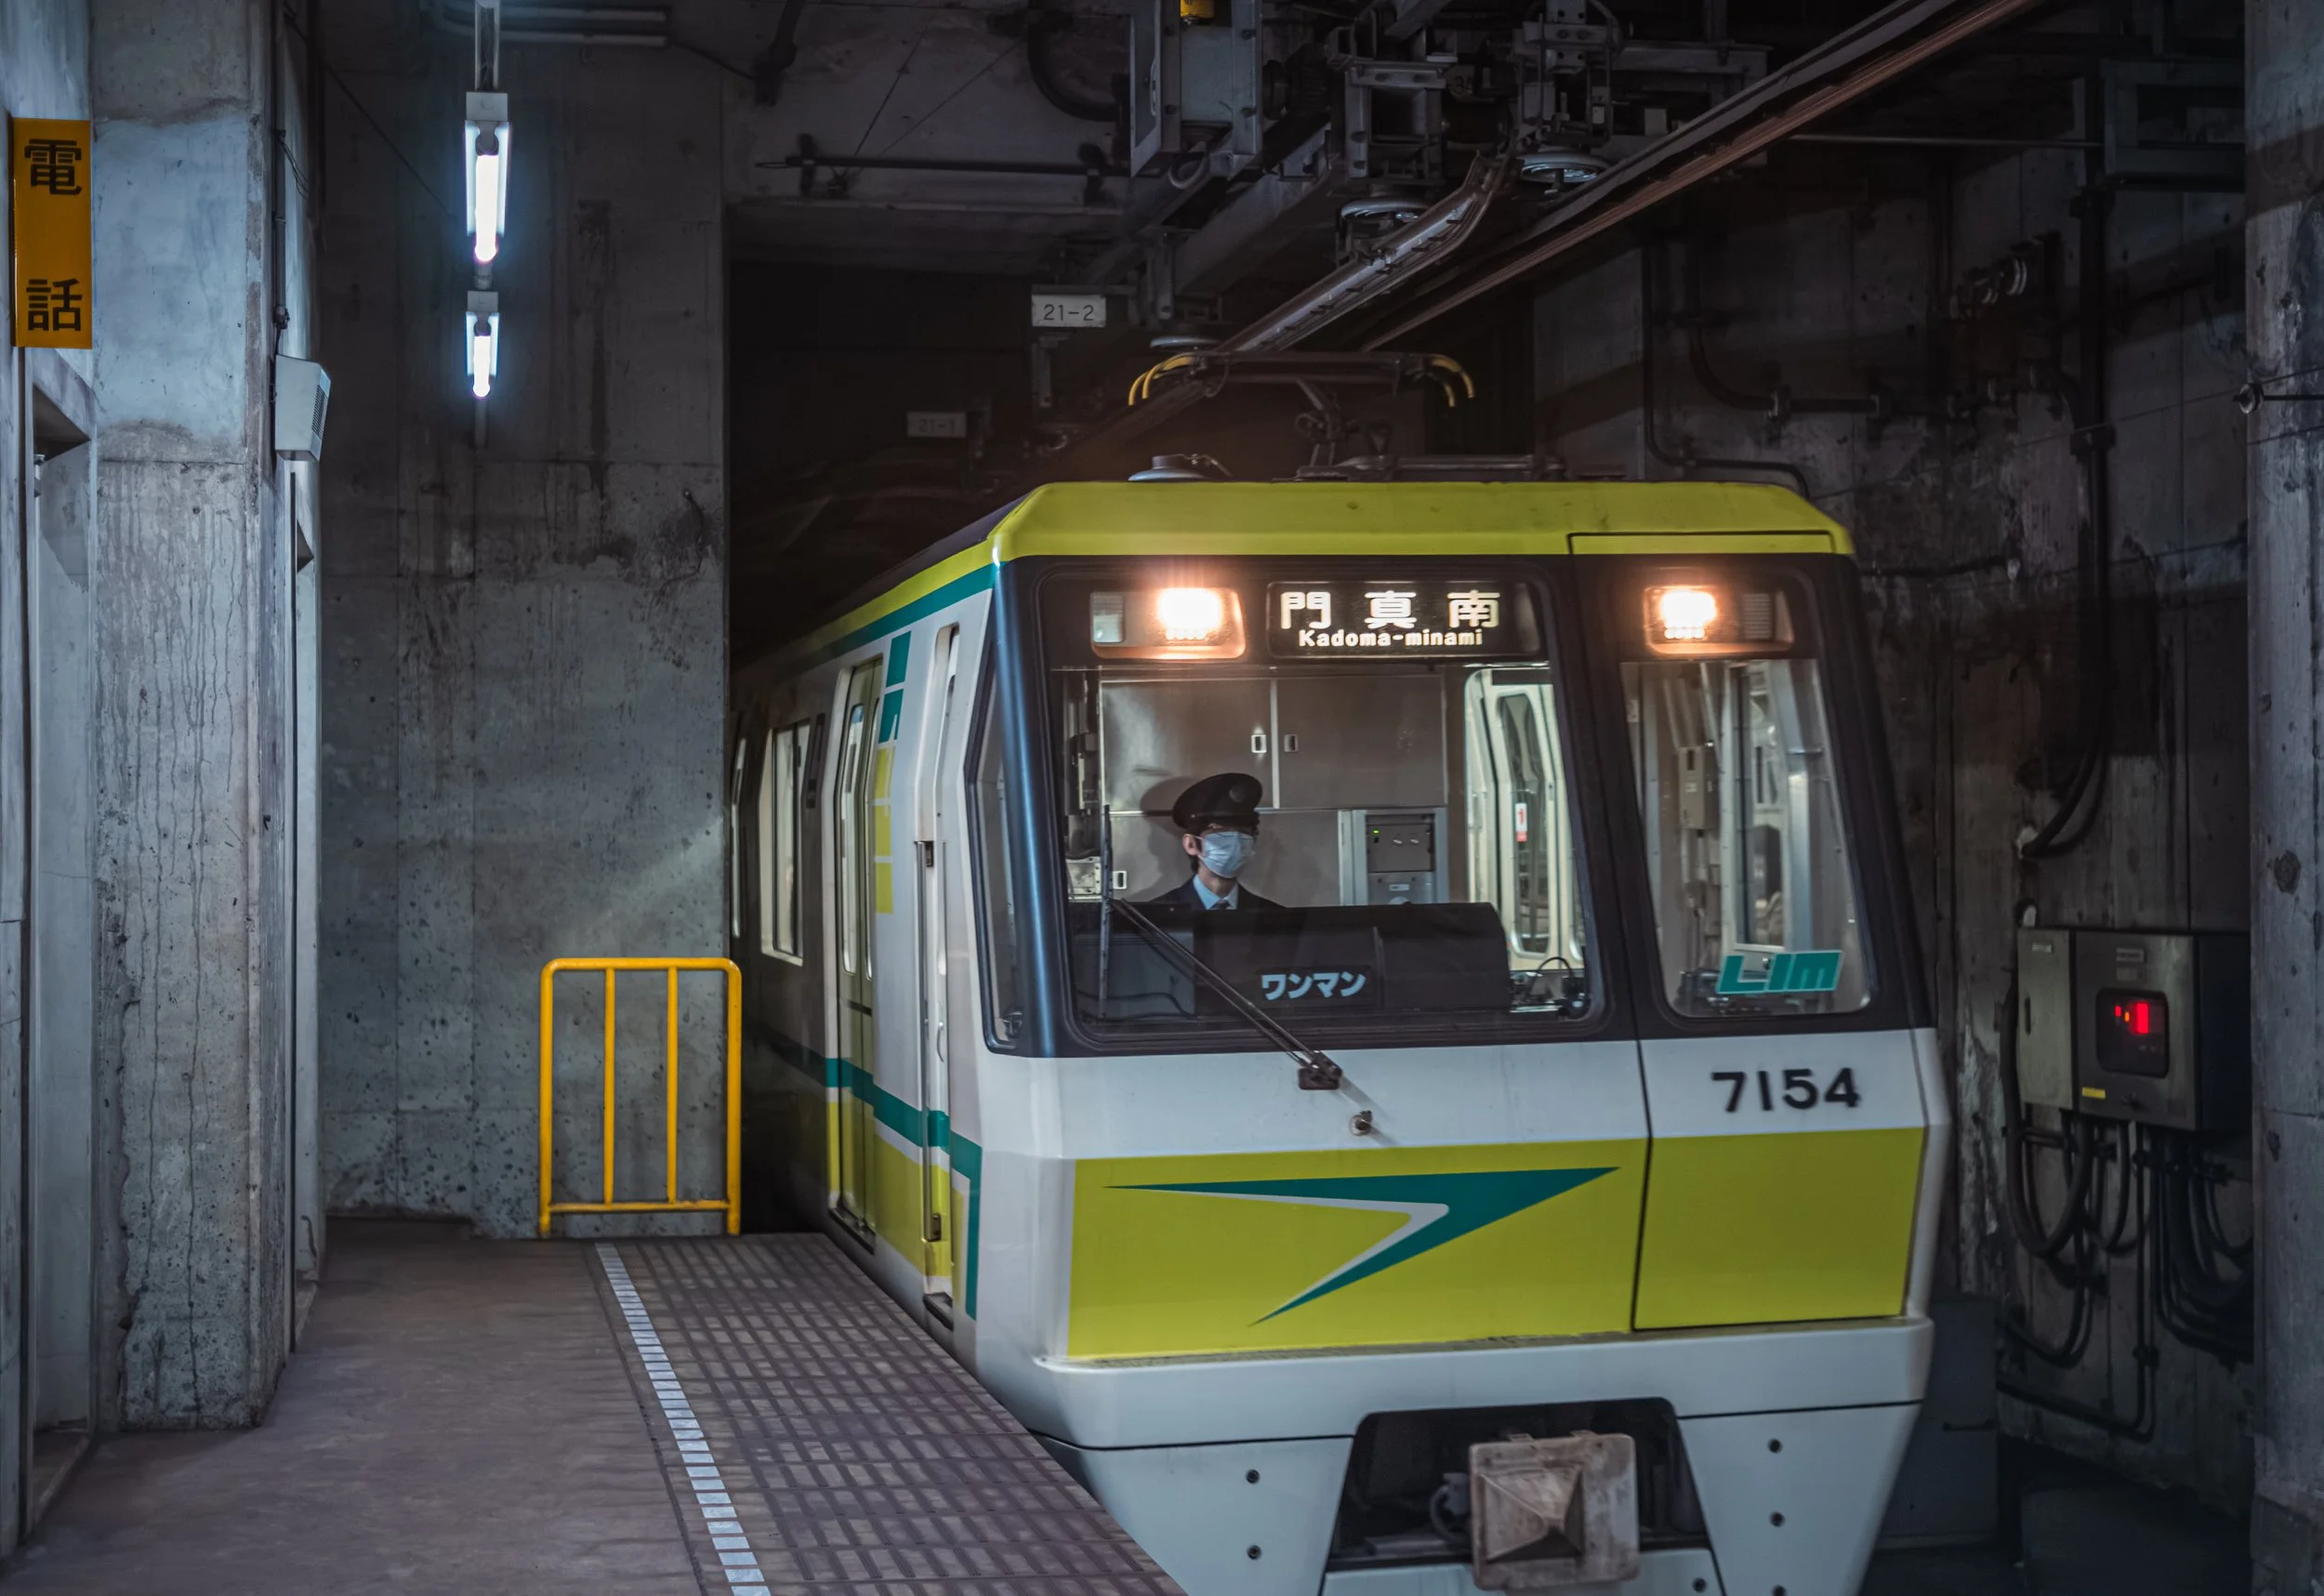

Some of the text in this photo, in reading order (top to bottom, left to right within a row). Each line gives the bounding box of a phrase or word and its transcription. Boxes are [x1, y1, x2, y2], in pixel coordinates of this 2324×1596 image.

[24, 138, 83, 332] 電話
[1042, 303, 1095, 322] 21-2
[1280, 589, 1501, 630] 門真南
[1298, 628, 1484, 648] Kadoma-minami
[1261, 970, 1367, 1001] ワンマン
[1710, 1066, 1862, 1114] 7154
